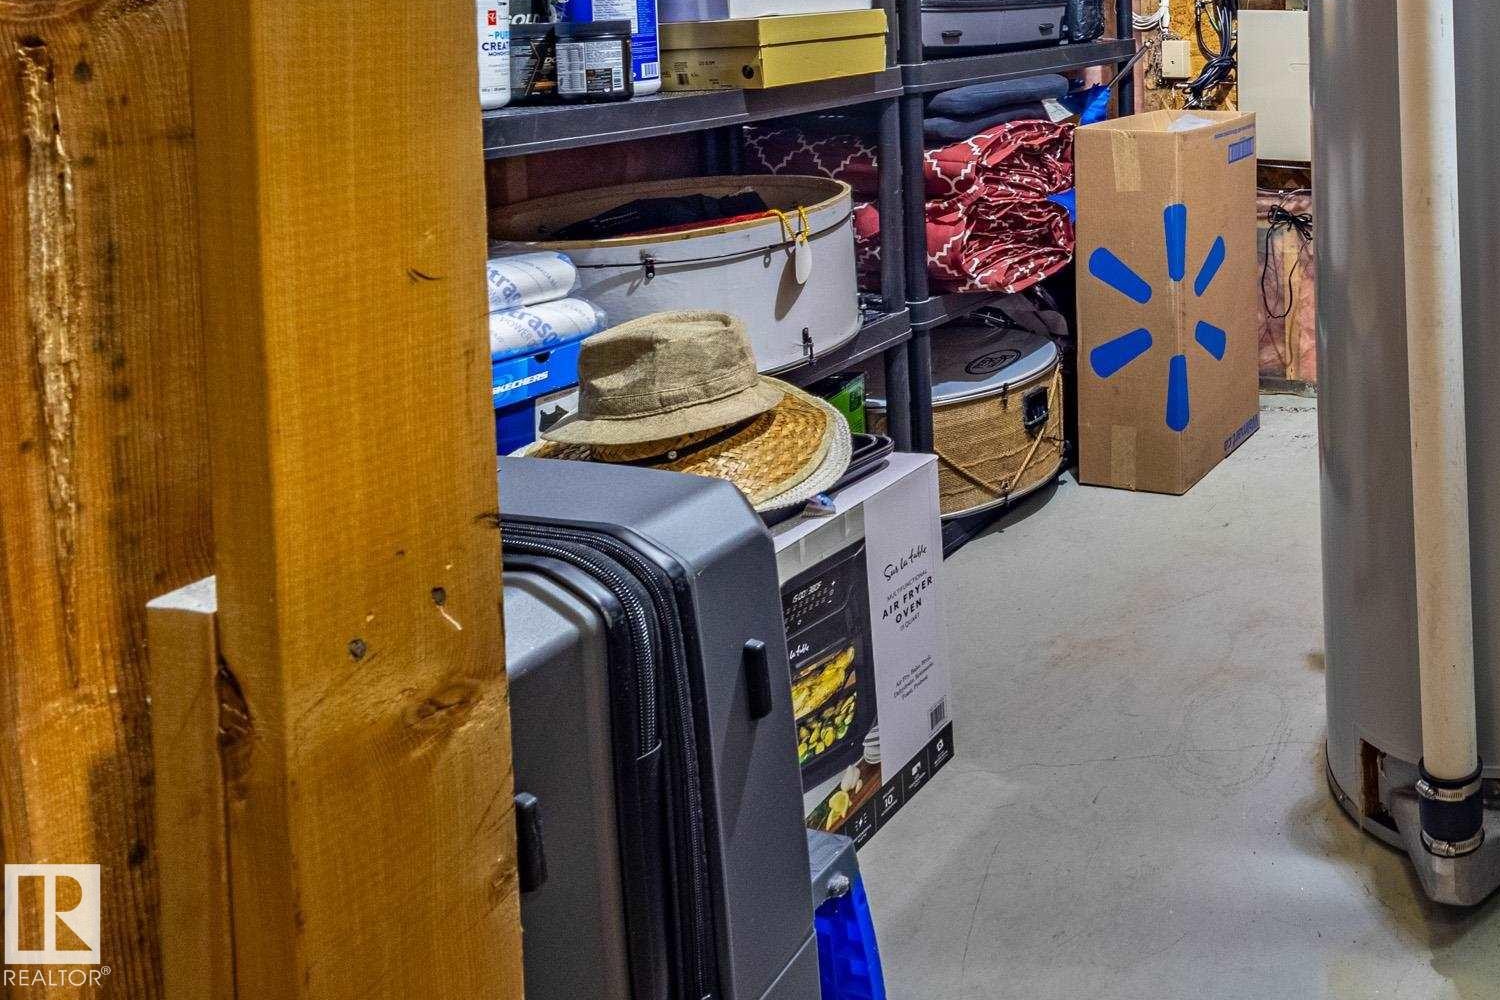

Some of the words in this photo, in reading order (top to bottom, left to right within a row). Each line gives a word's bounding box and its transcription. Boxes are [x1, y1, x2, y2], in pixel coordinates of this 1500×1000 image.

[482, 42, 509, 50] CREA
[883, 564, 898, 582] Sur
[900, 557, 908, 570] la
[908, 544, 928, 564] table
[882, 600, 899, 620] AIR
[903, 576, 933, 604] FRYER
[895, 598, 922, 623] OVEN
